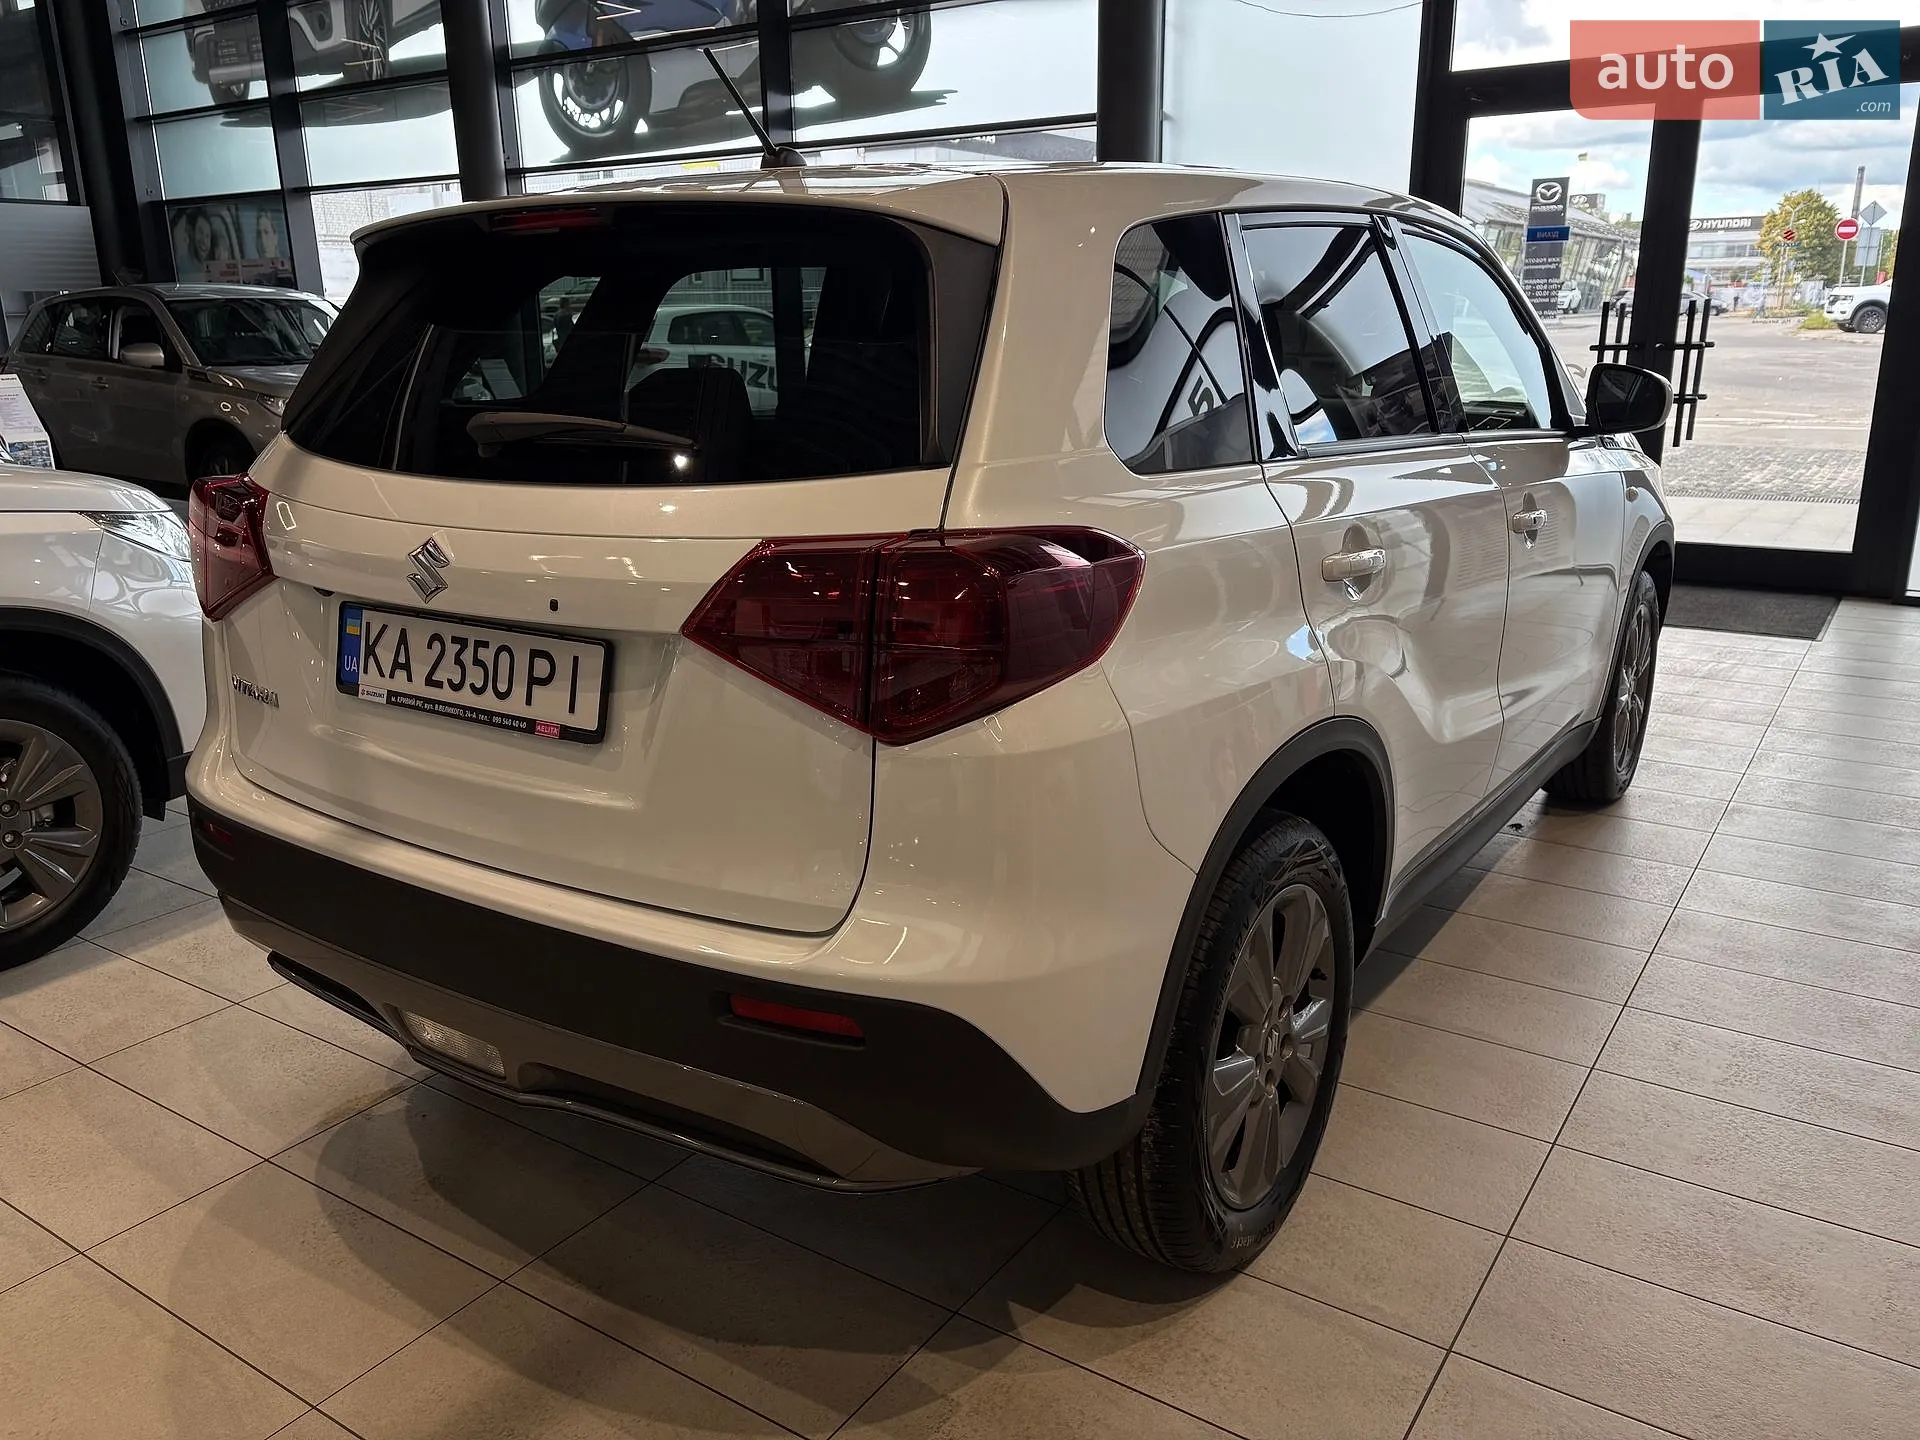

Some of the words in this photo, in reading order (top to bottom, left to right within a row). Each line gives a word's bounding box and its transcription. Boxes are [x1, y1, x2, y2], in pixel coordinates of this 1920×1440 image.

[1702, 218, 1752, 229] HYUNDAI
[344, 654, 359, 673] UA
[363, 621, 414, 683] KA
[424, 632, 515, 701] 2350
[366, 690, 385, 699] SUZUKI
